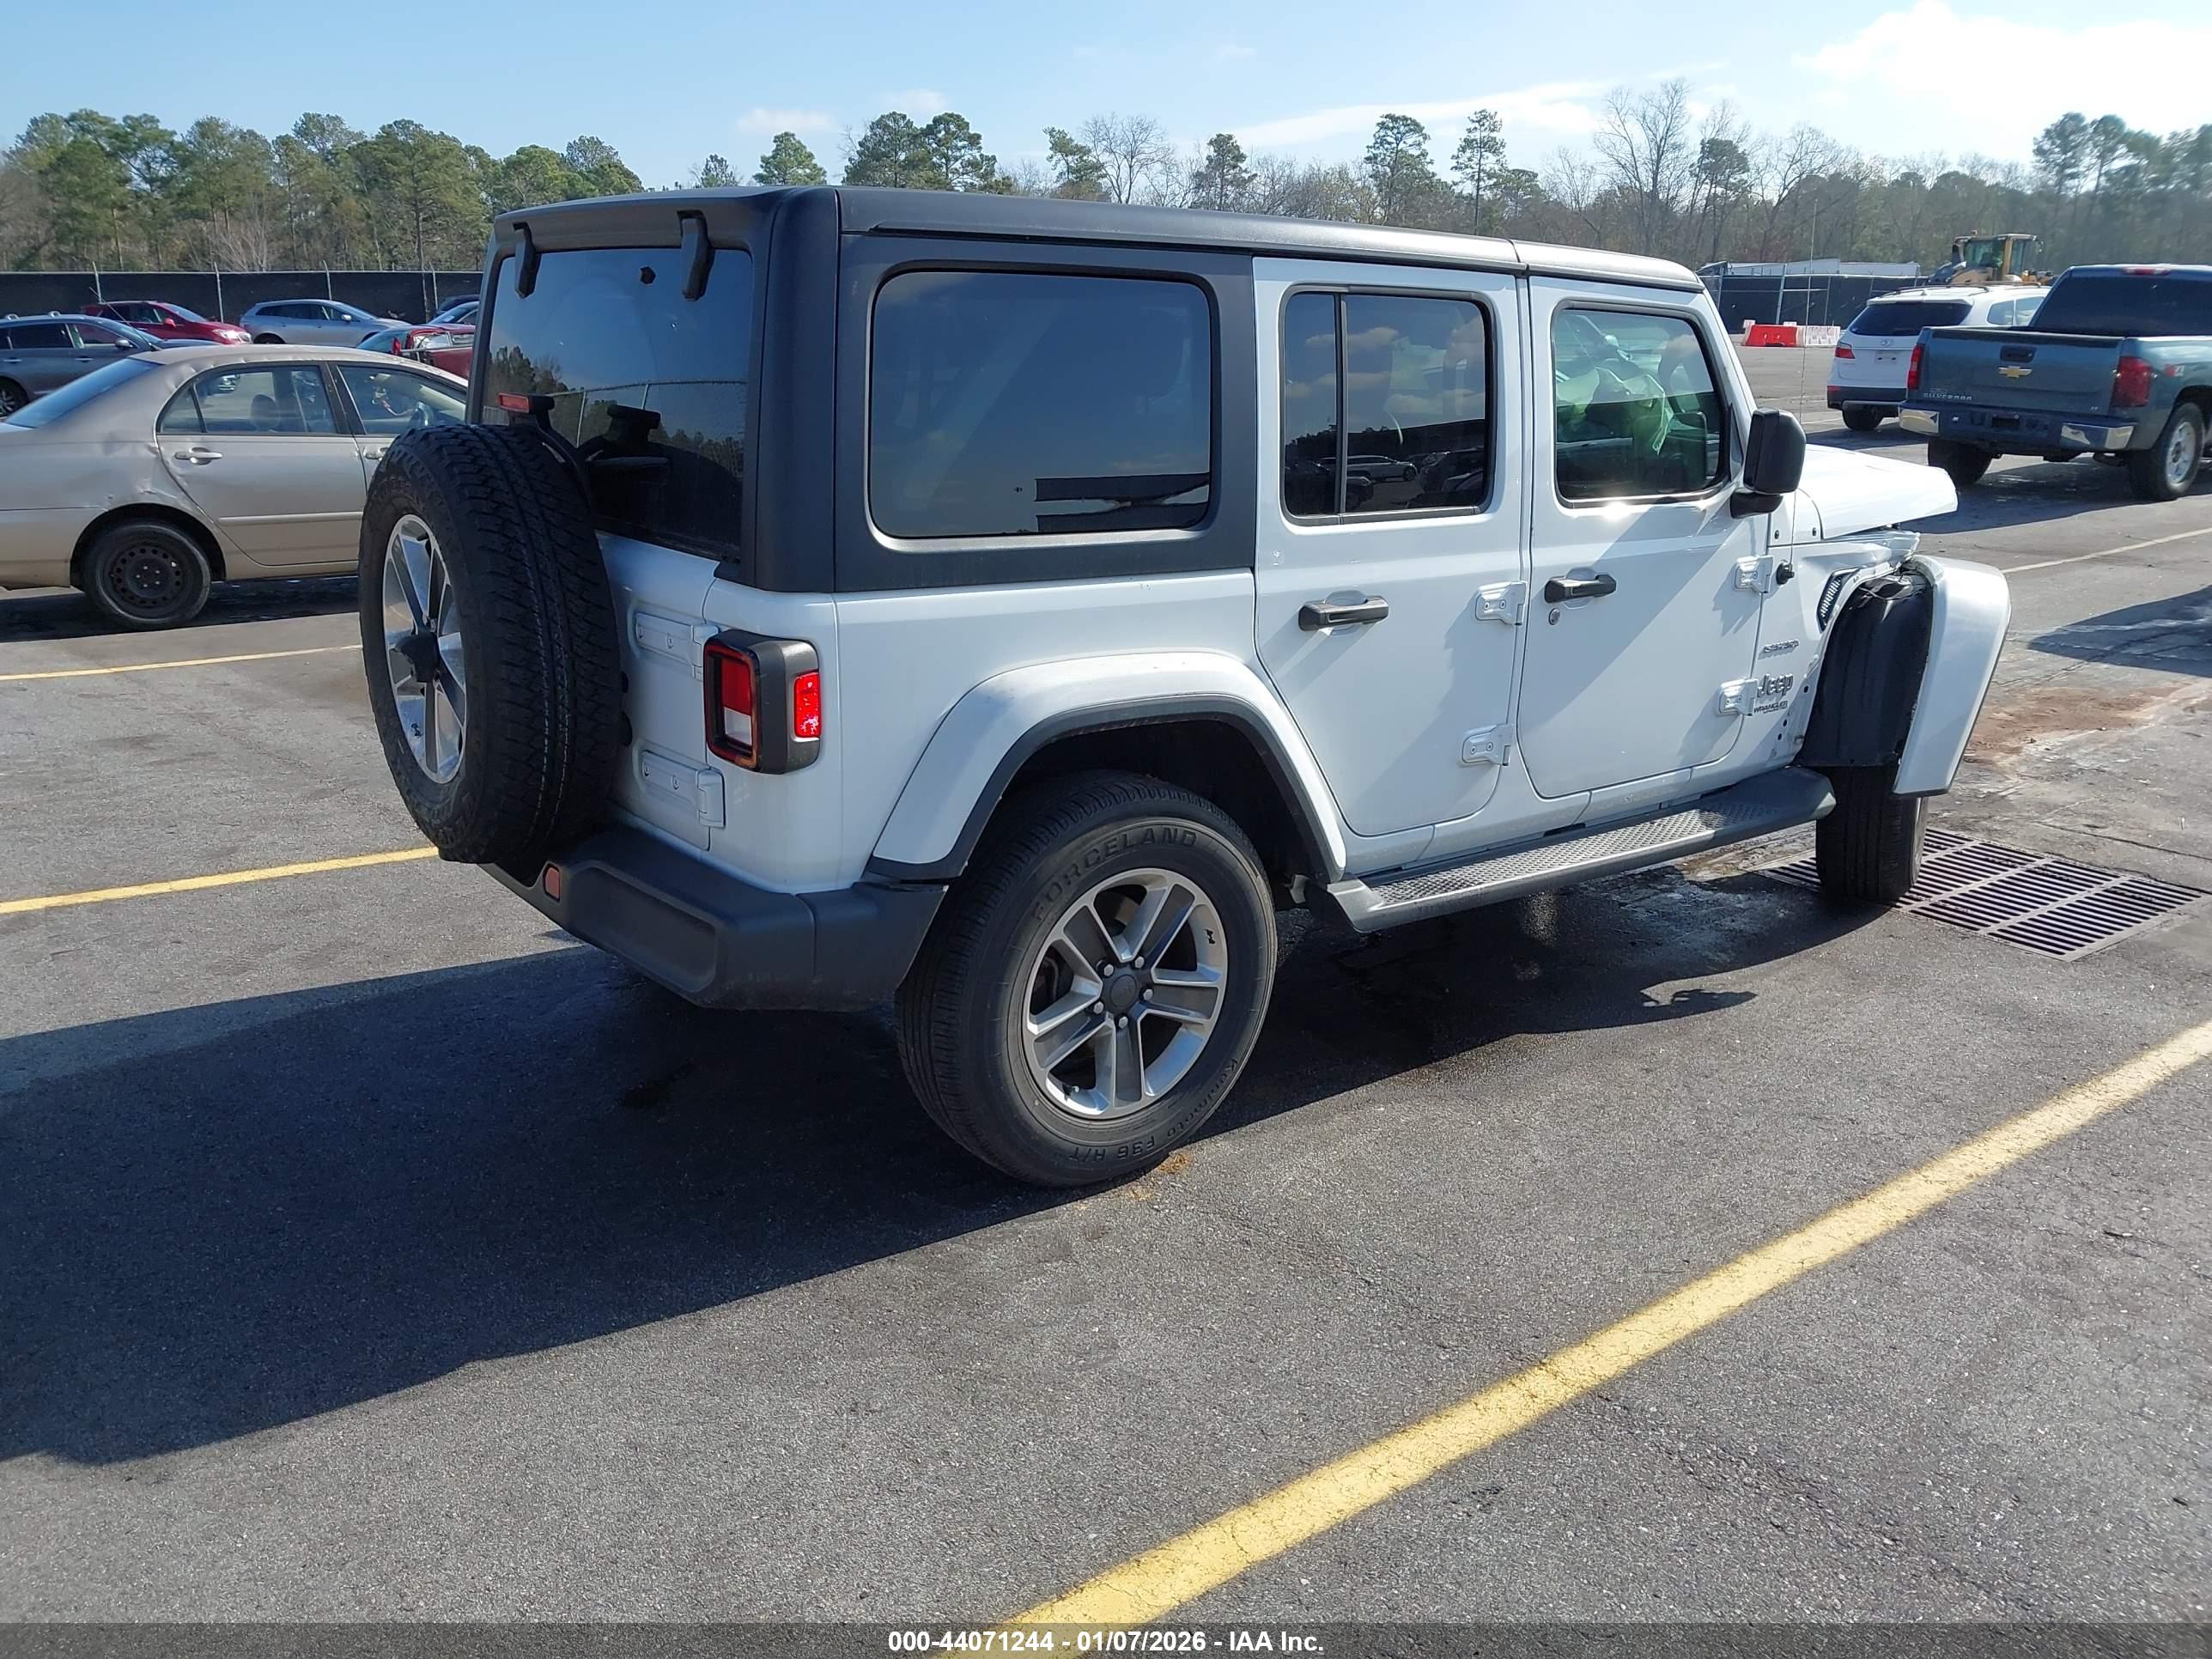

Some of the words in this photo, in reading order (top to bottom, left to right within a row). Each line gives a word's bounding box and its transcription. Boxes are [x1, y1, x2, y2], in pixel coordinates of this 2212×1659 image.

[1757, 673, 1794, 698] Jeep
[1031, 826, 1198, 921] FORCELAND
[1117, 1135, 1156, 1159] F36
